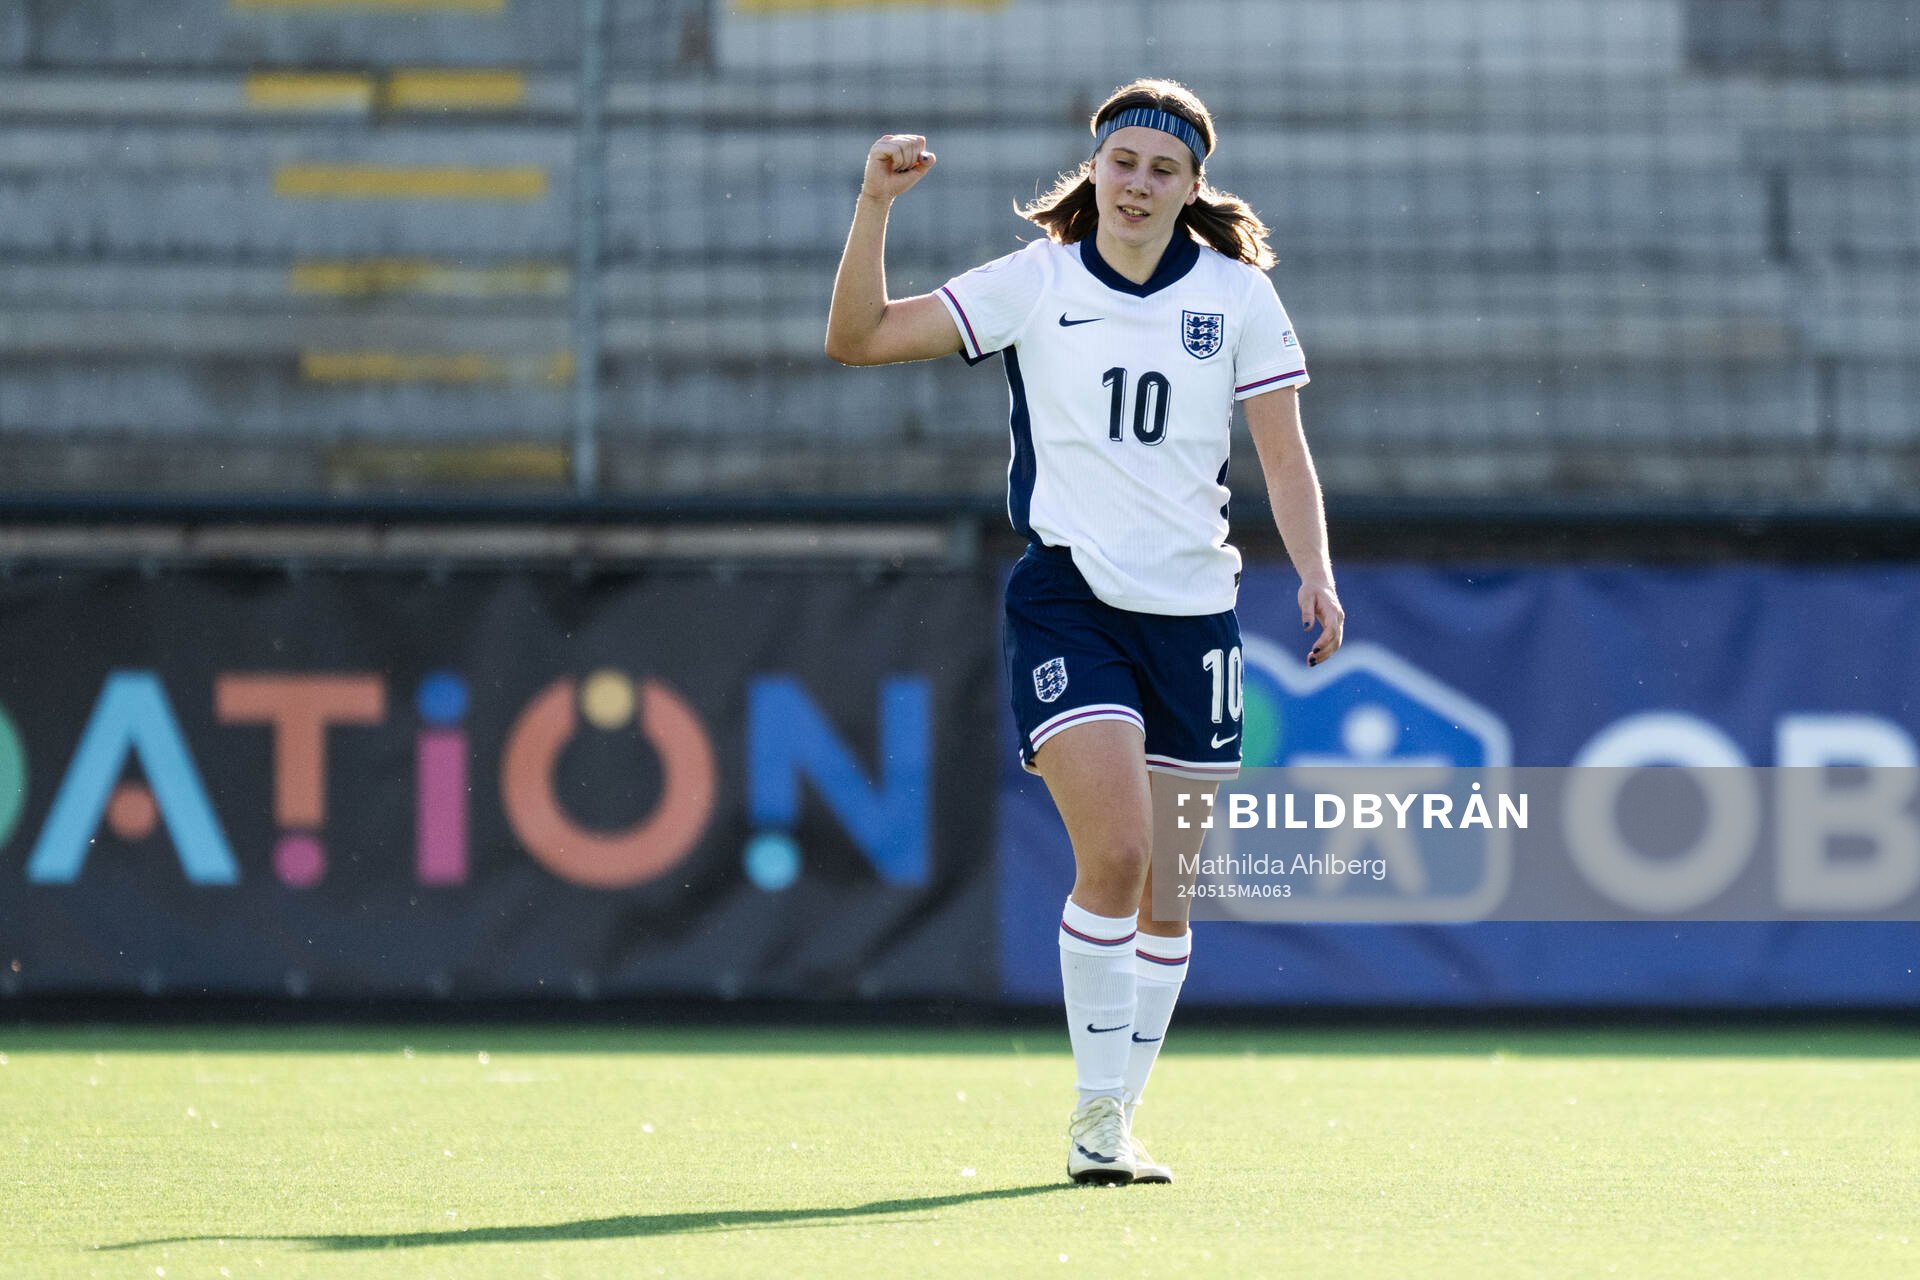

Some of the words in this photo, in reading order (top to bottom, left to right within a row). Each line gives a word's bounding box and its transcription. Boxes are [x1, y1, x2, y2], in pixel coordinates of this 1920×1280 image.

[1102, 366, 1171, 446] 10
[1202, 645, 1243, 724] 10
[1564, 712, 1920, 914] OB
